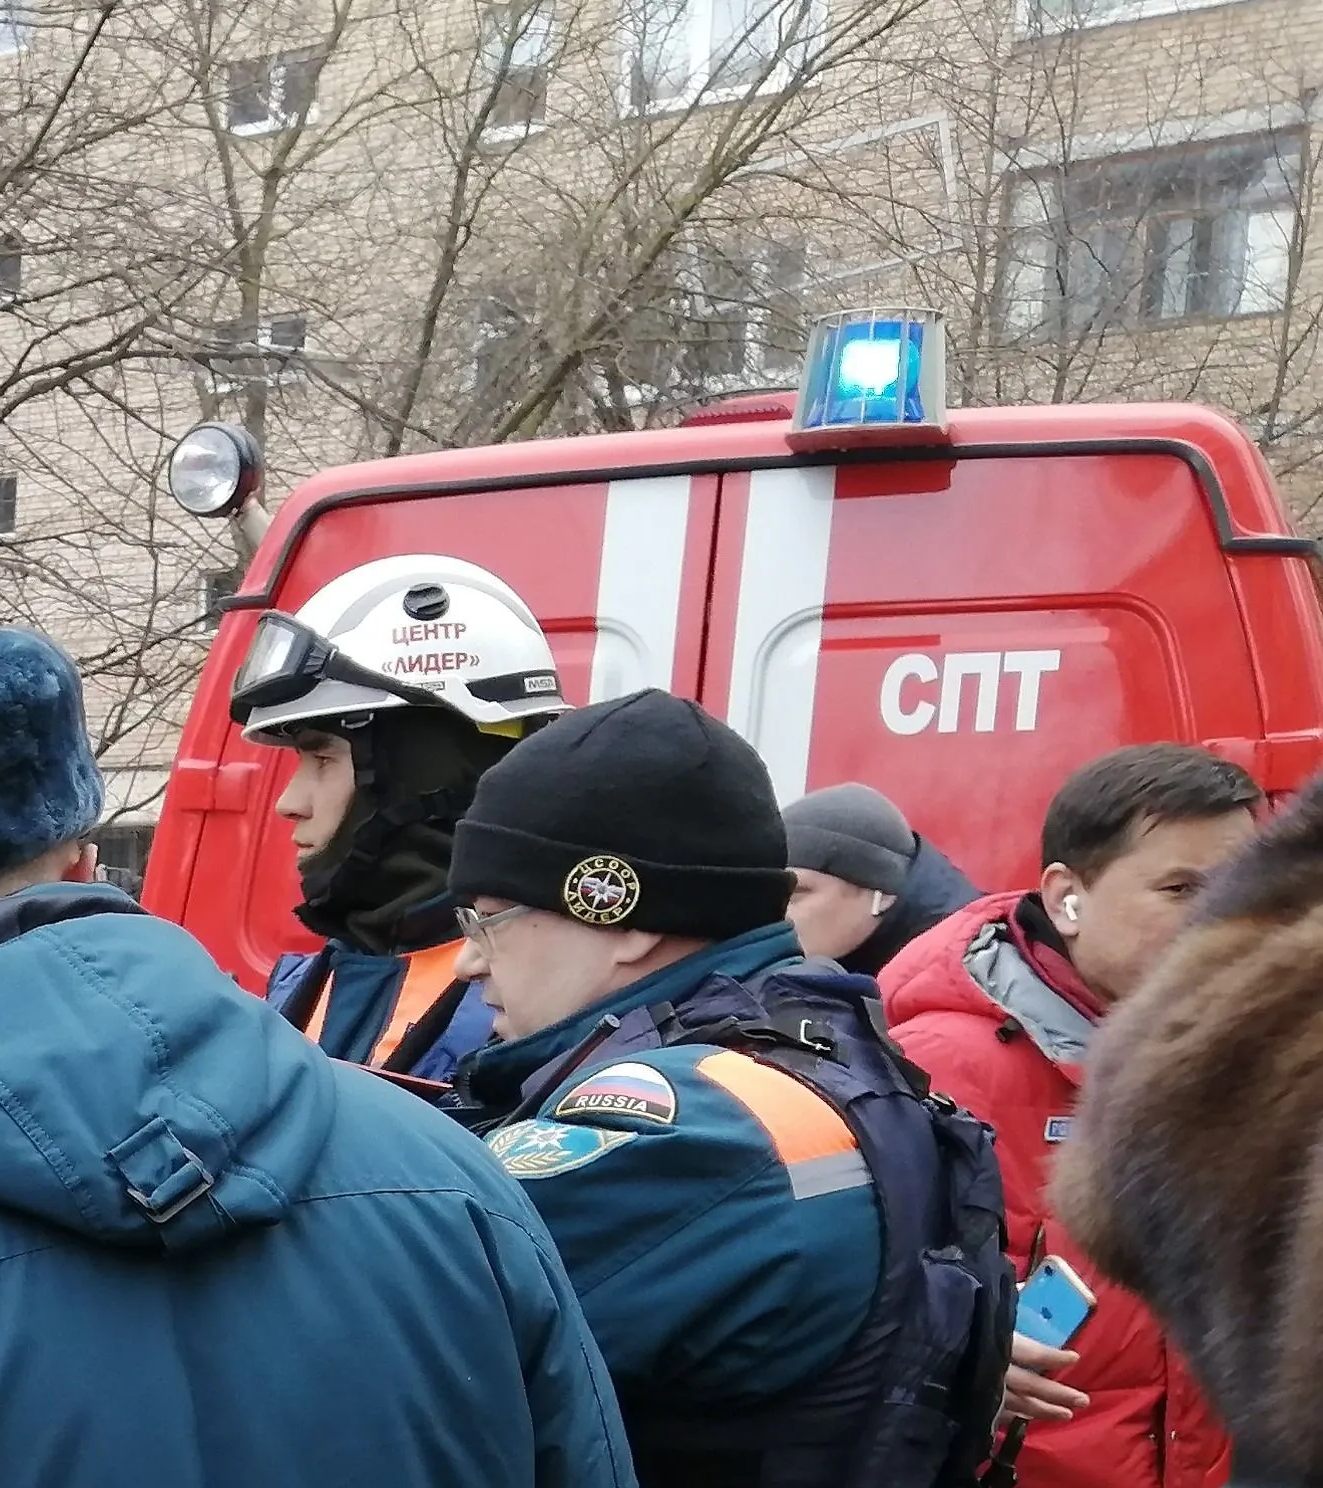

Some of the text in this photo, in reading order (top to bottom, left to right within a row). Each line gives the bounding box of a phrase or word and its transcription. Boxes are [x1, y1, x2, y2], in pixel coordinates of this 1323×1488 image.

[392, 623, 467, 646] ЦЕНТР
[381, 652, 480, 675] «ЛИДЕР»
[880, 650, 1061, 735] СПТ
[567, 890, 624, 923] ЛИДЕР
[575, 1094, 647, 1112] RUSSIA
